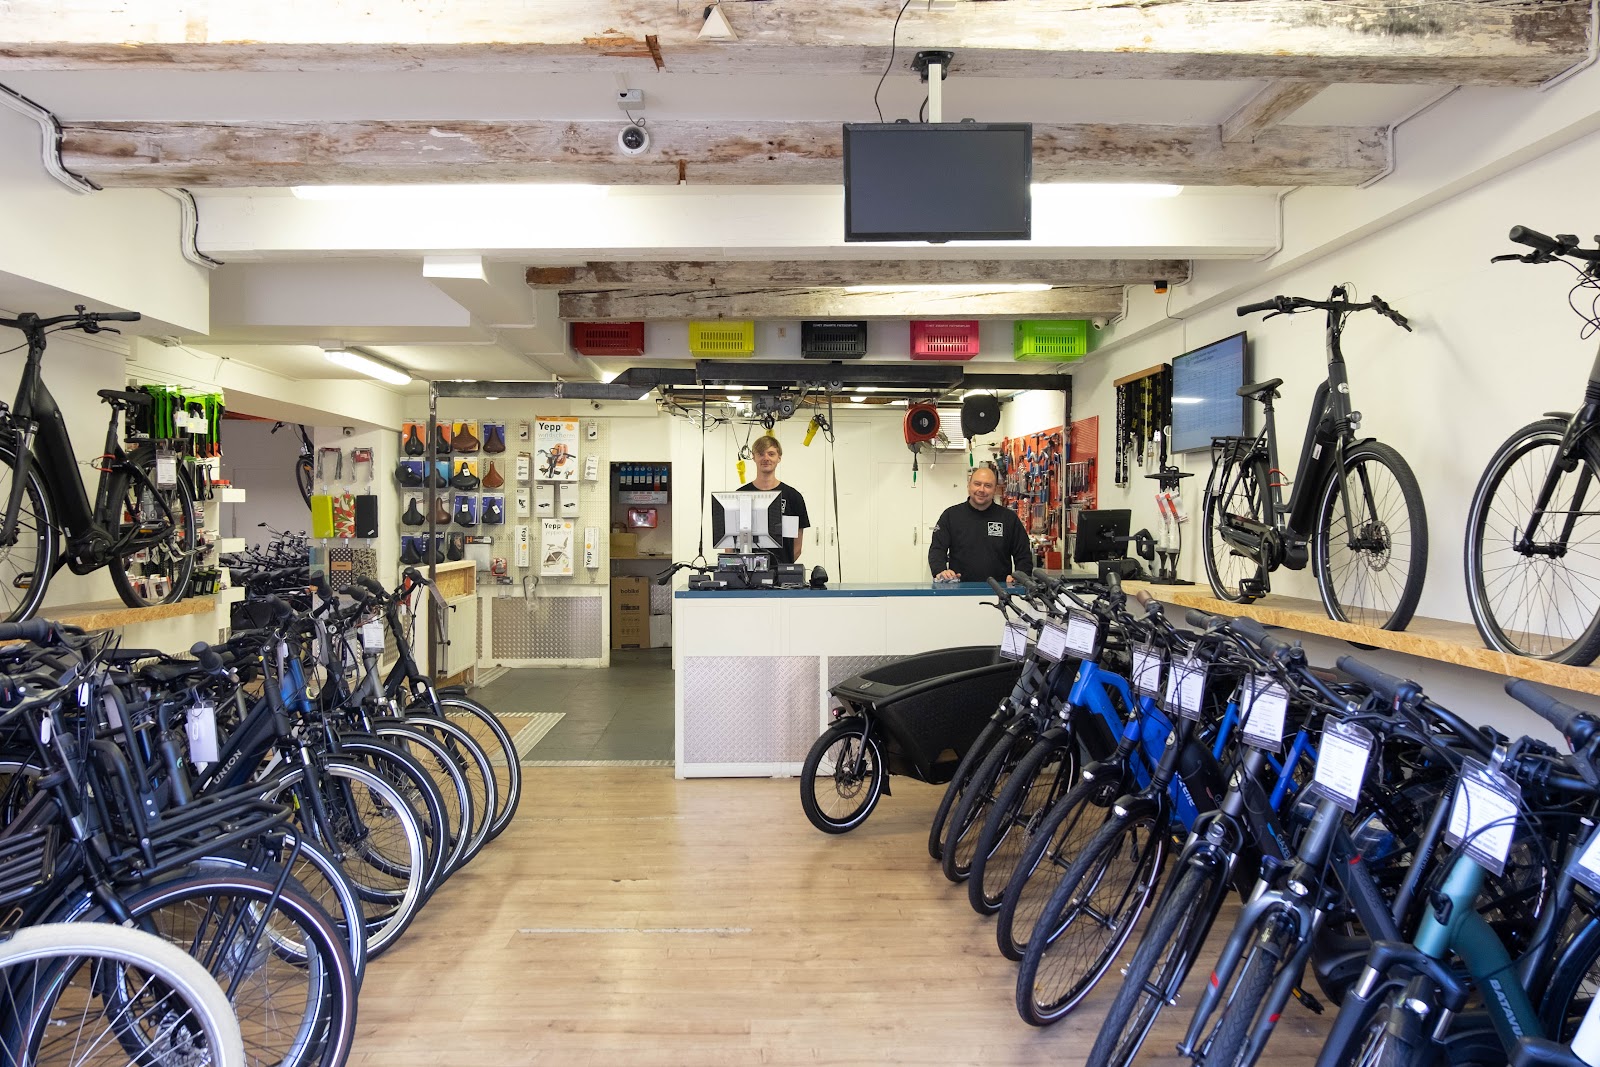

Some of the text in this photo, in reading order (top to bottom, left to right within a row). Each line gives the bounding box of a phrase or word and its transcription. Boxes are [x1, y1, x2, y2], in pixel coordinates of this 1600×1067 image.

[538, 422, 561, 432] Yepp
[544, 522, 561, 530] Yepp
[212, 749, 242, 784] UNION
